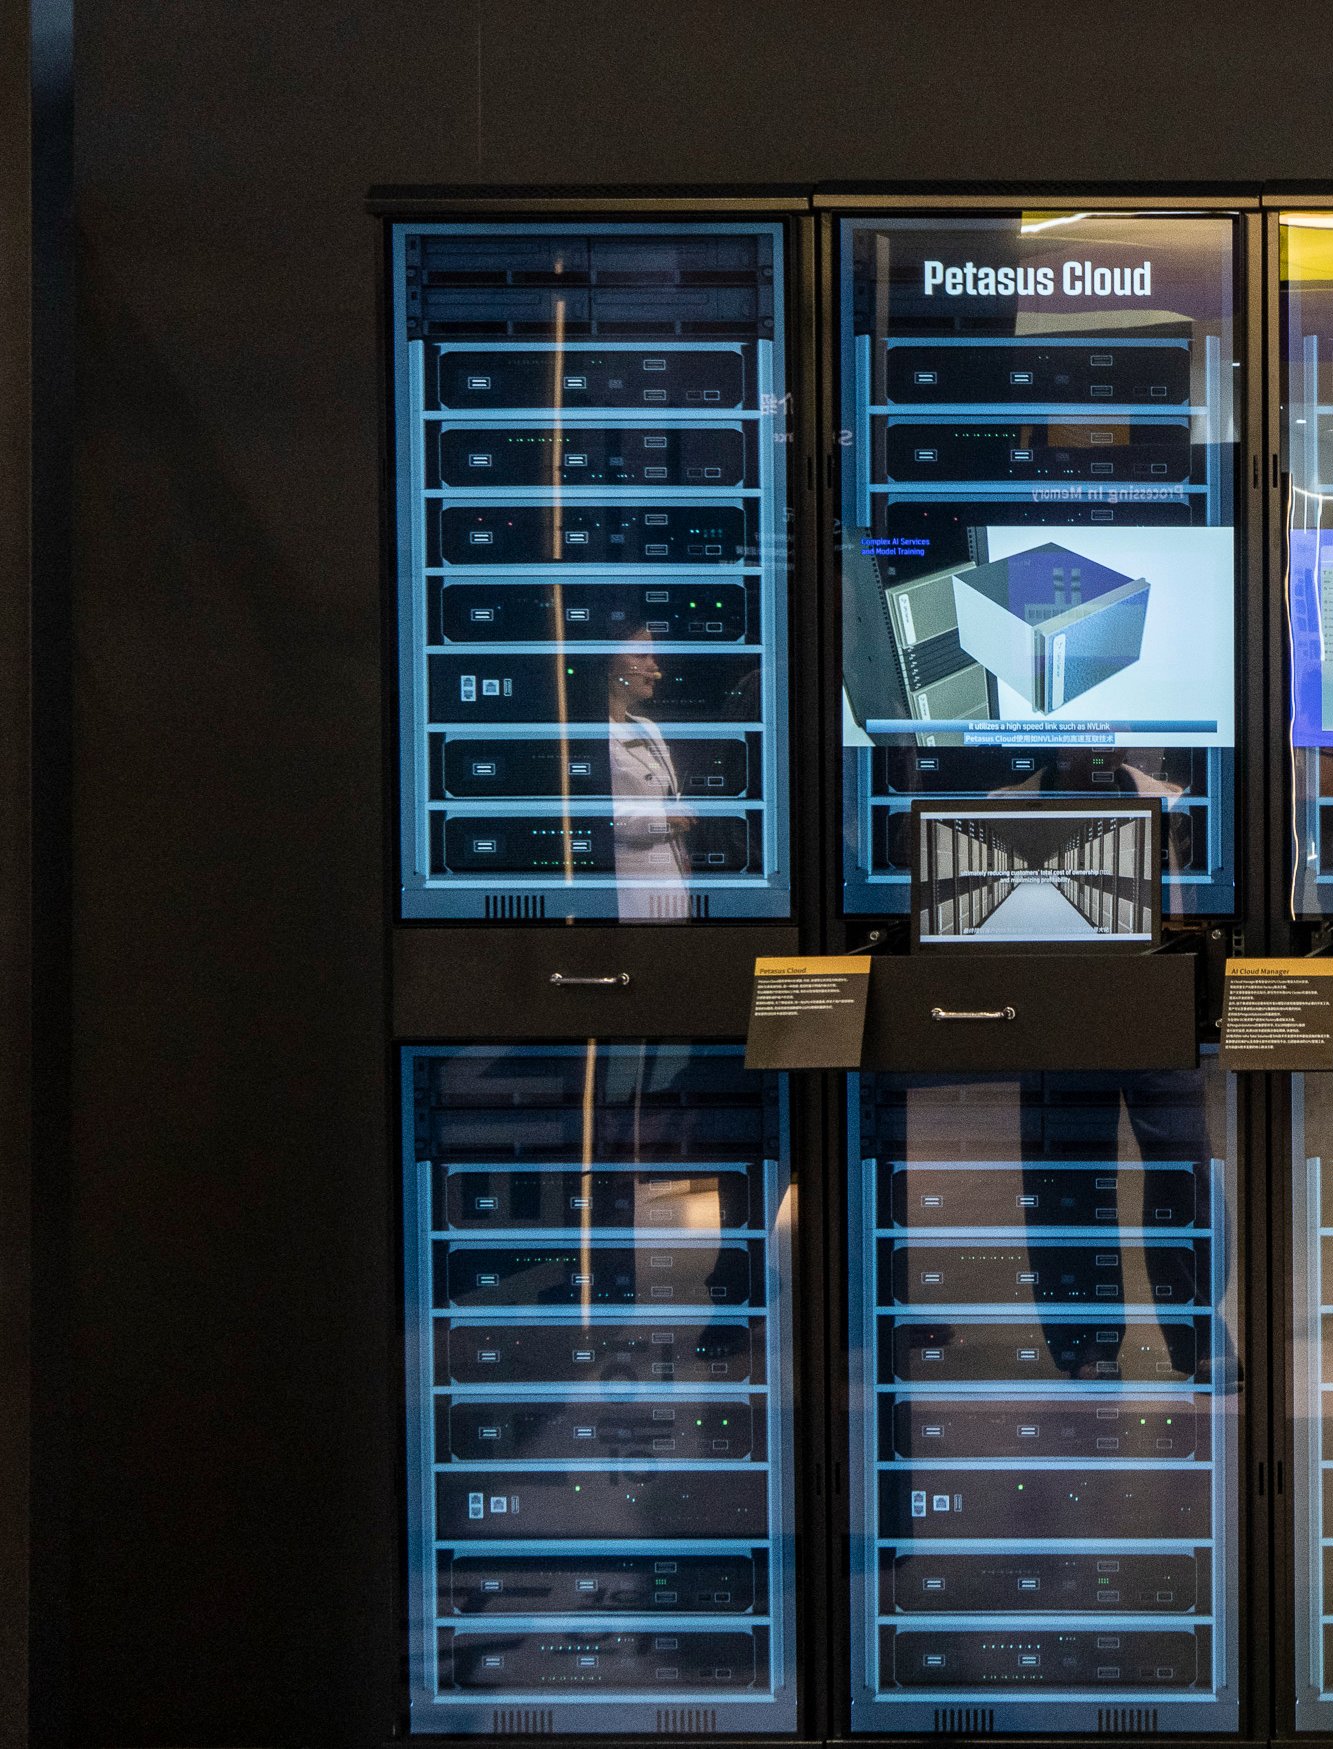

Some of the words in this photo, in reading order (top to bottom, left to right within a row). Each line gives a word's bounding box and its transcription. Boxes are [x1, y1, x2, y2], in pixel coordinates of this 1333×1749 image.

[924, 260, 1055, 296] Petasus
[1062, 261, 1151, 296] Cloud
[861, 538, 891, 547] Complex
[892, 538, 899, 546] AI
[900, 538, 930, 546] Services
[861, 548, 874, 556] and
[875, 548, 897, 556] Model
[898, 548, 925, 557] Training
[975, 722, 1000, 731] utilizes
[1006, 722, 1021, 732] high
[1022, 722, 1044, 732] speed
[1045, 722, 1058, 731] link
[1059, 722, 1076, 731] such
[1077, 723, 1086, 731] as
[1086, 722, 1110, 731] NVLink
[965, 735, 994, 744] Petasus
[1261, 968, 1289, 977] Manager
